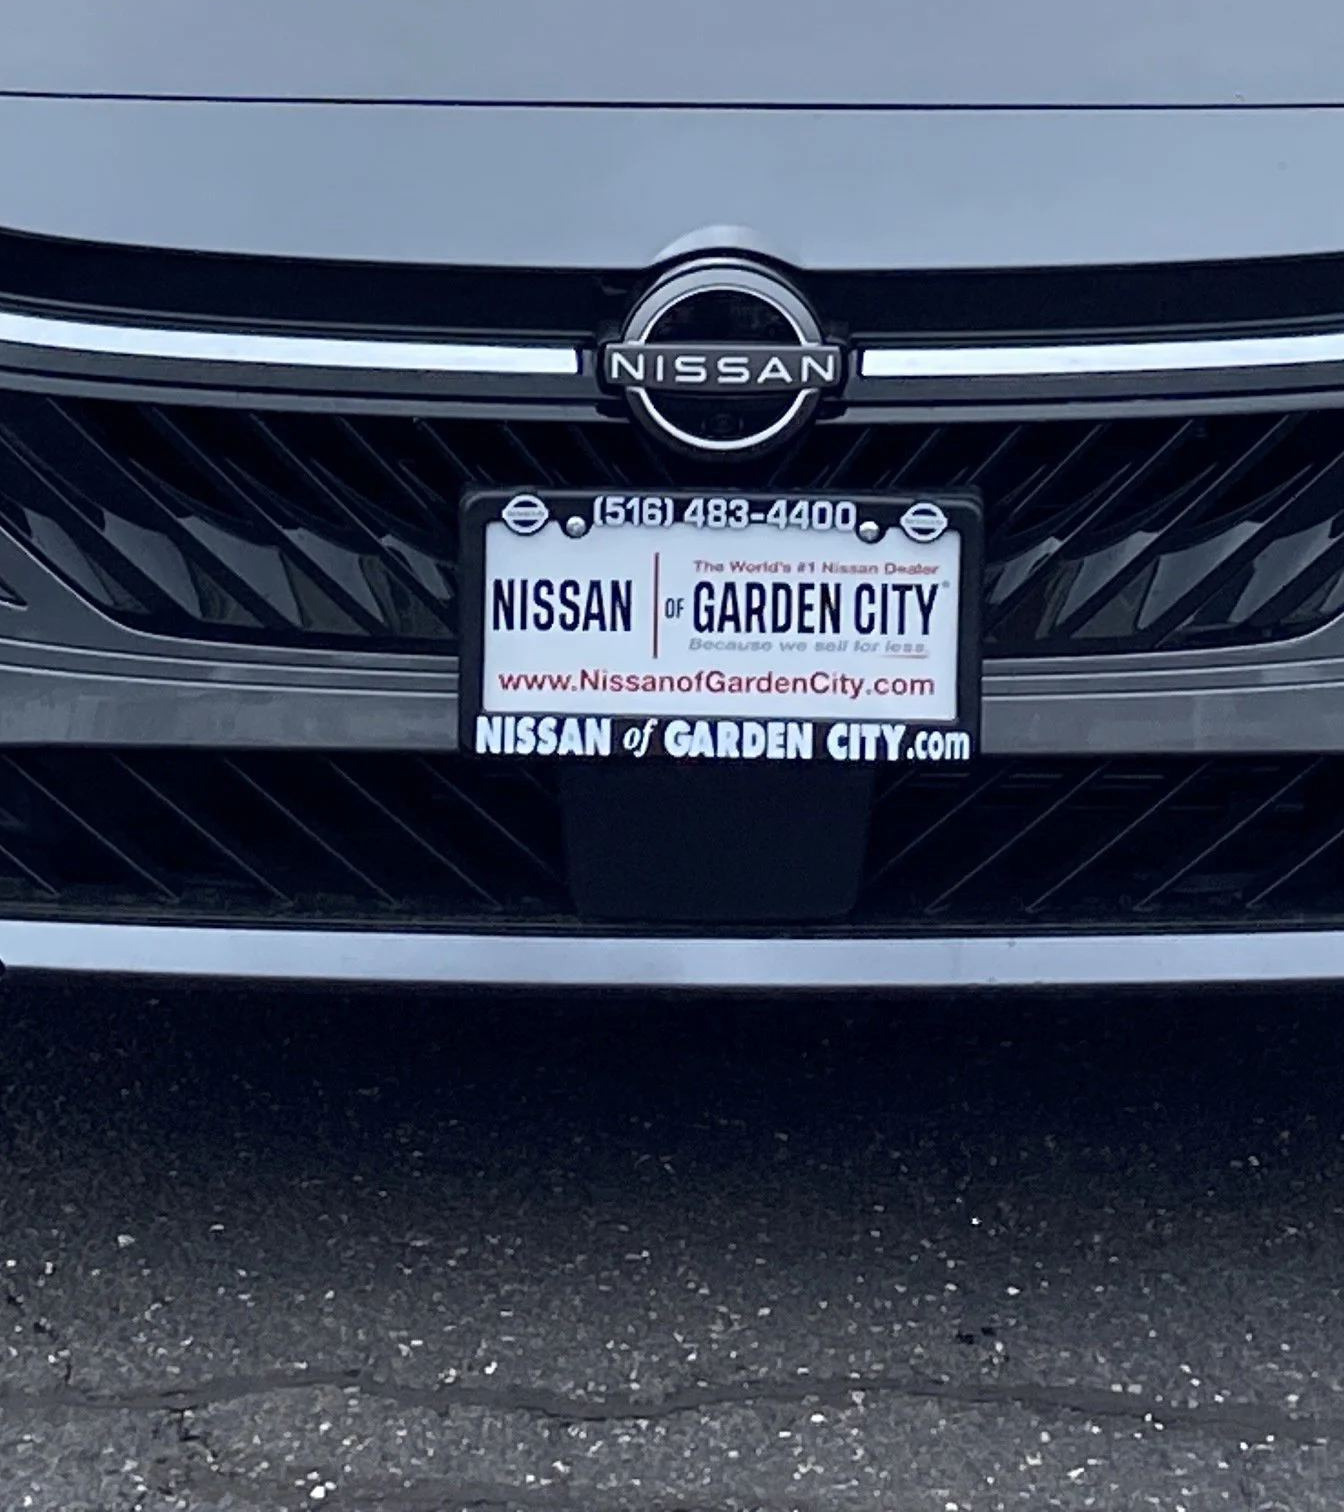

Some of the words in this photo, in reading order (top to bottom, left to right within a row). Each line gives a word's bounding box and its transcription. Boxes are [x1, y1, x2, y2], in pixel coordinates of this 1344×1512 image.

[611, 352, 835, 384] NISSAN
[593, 495, 675, 529] (516)
[682, 497, 857, 531] 483-4400
[693, 560, 724, 573] The
[729, 560, 791, 574] World's
[796, 561, 816, 574] #1
[821, 561, 879, 574] Nissan
[884, 562, 940, 575] Dealer
[492, 578, 633, 632] NISSAN
[664, 597, 685, 619] OF
[693, 580, 842, 634] GARDEN
[854, 582, 939, 636] CITY
[688, 637, 774, 652] Because
[779, 640, 808, 652] we
[814, 639, 848, 653] sell
[853, 640, 880, 653] for
[499, 668, 935, 699] www.NissanofGardenCity.com
[475, 715, 612, 756] NISSAN
[622, 717, 657, 759] of
[663, 719, 814, 760] GARDEN
[826, 723, 971, 761] CITY.com
